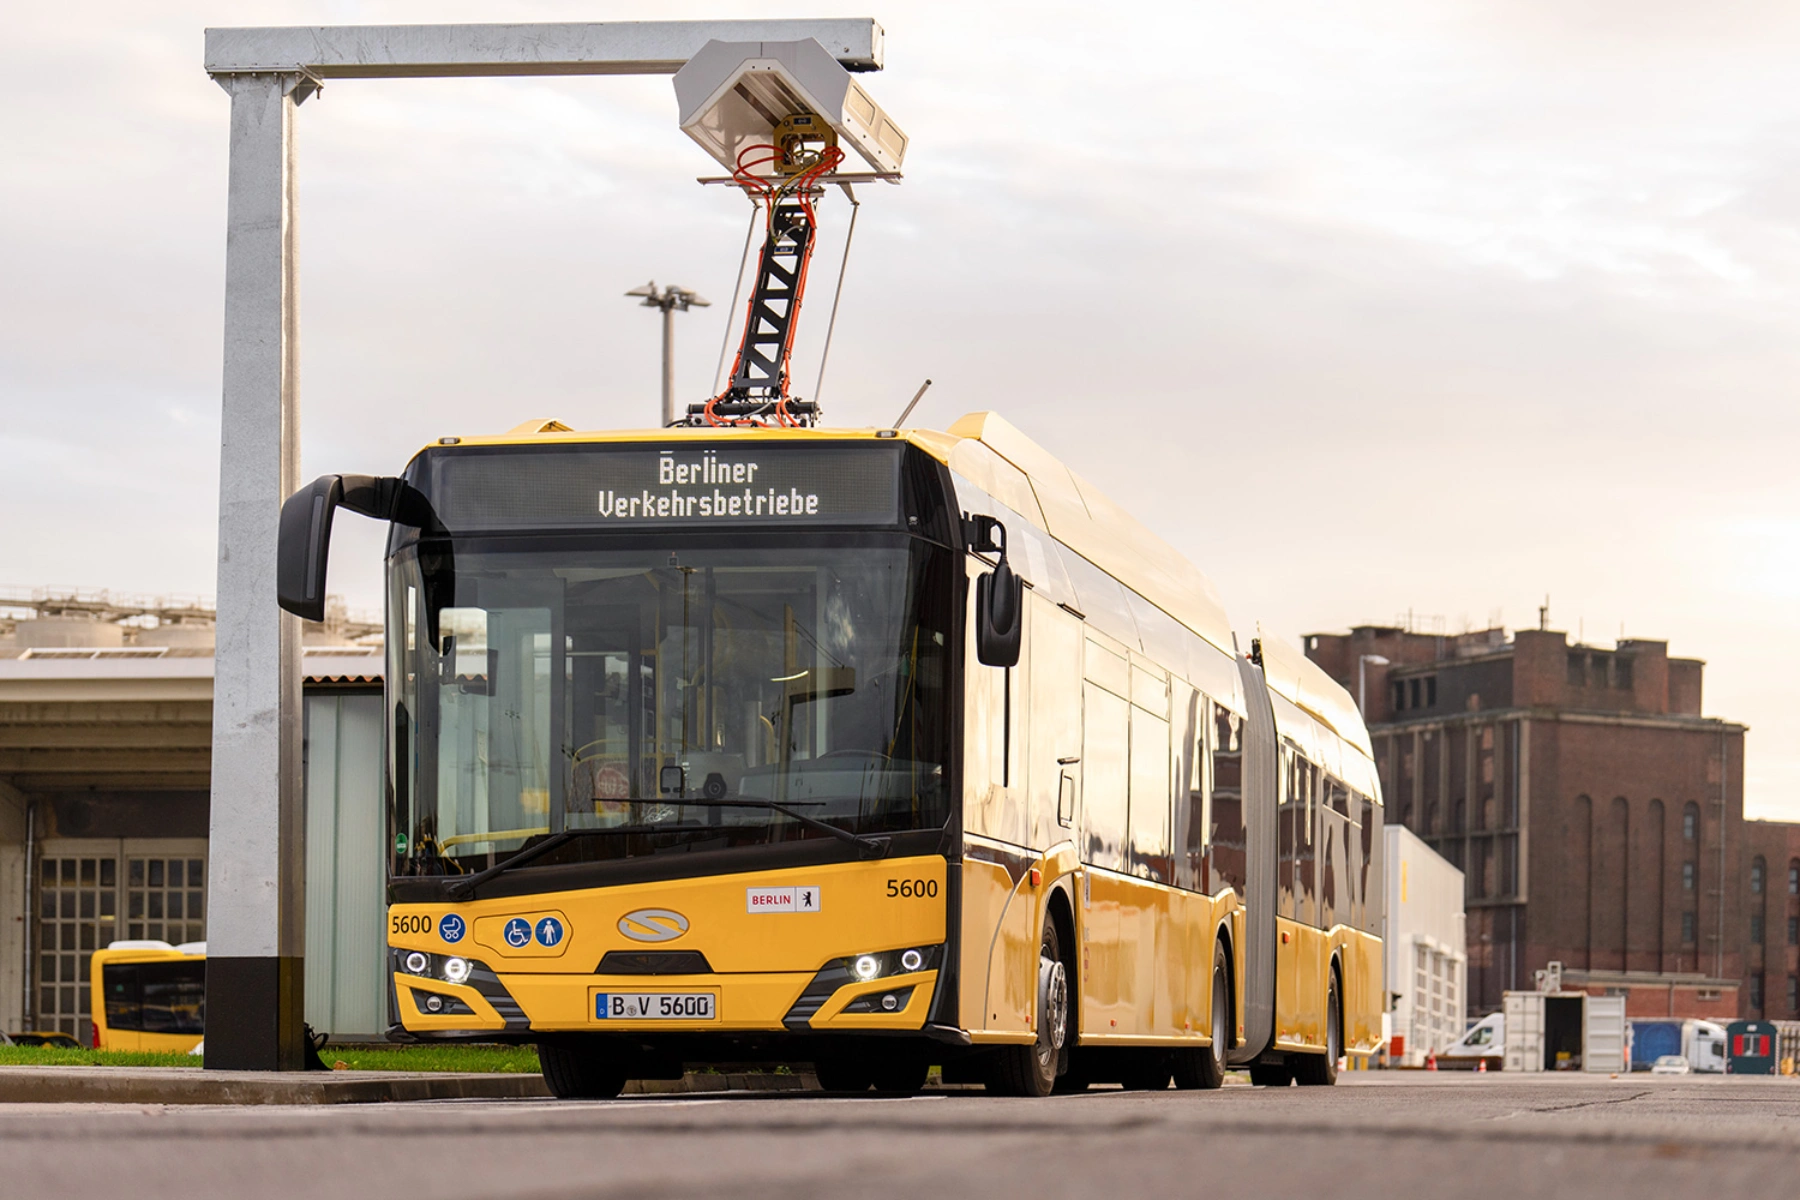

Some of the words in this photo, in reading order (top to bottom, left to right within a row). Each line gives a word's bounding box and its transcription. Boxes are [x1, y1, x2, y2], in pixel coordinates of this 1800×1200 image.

[659, 450, 758, 484] Berliner
[598, 487, 819, 517] Verkehrsbetriebe
[886, 879, 938, 898] 5600
[752, 895, 791, 906] BERLIN
[392, 915, 432, 934] 5600
[612, 996, 625, 1016] B
[638, 996, 650, 1016] V
[660, 996, 709, 1016] 5600
